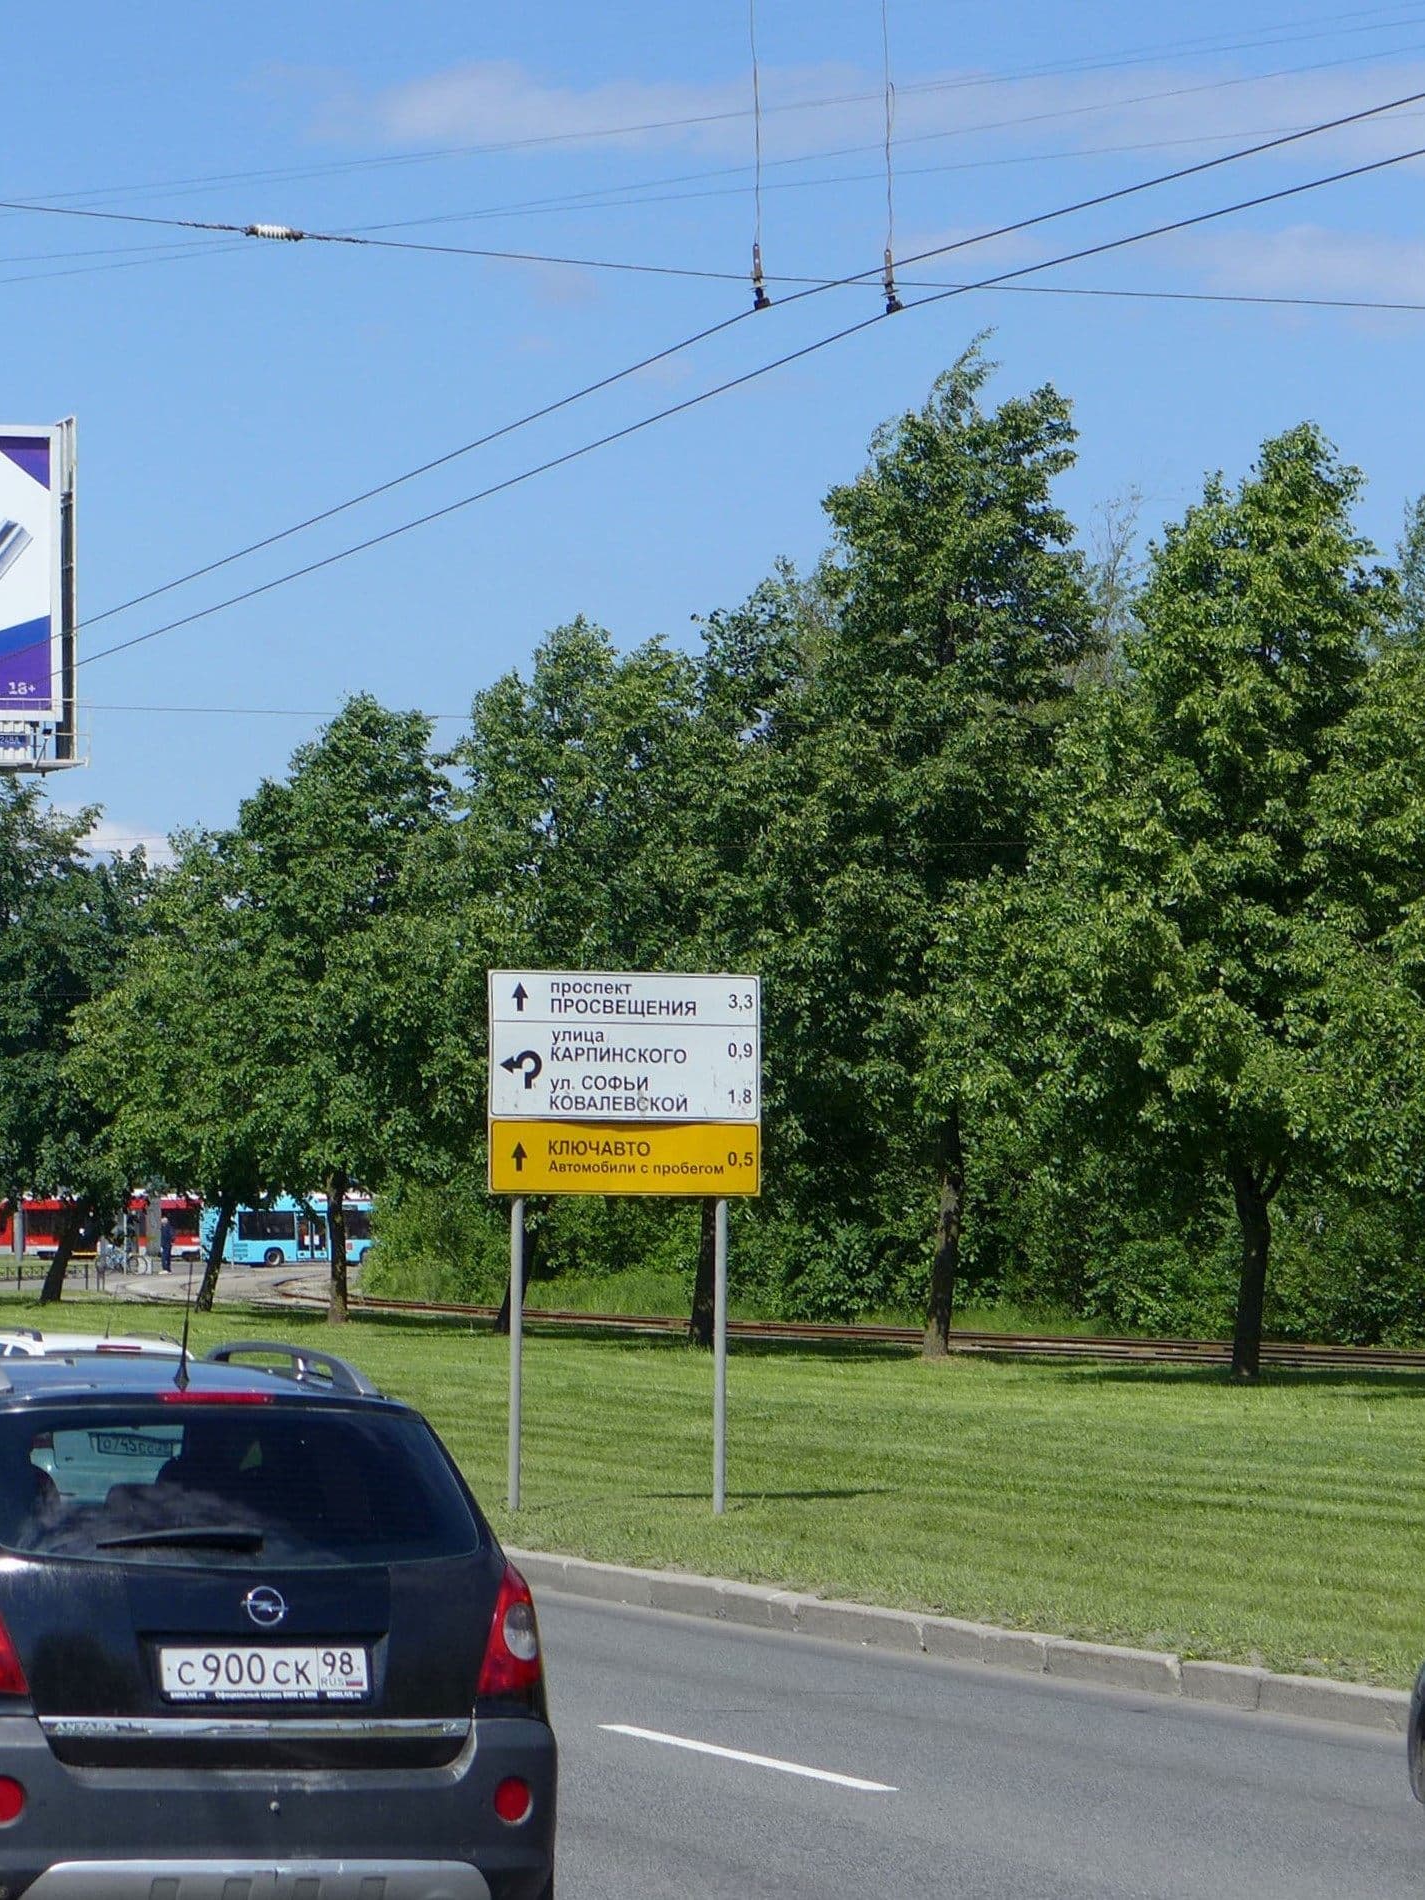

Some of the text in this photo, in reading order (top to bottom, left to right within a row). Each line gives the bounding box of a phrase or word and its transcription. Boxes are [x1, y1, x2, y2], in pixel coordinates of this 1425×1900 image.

[8, 682, 36, 695] 18+
[550, 981, 632, 997] проспект
[550, 994, 753, 1018] ПРОСВЕЩЕНИЯ 3,3
[551, 1029, 604, 1045] улица
[550, 1042, 753, 1064] КАРПИНСКОГО 0,9
[550, 1075, 649, 1094] ул. СОФЬИ
[549, 1088, 752, 1112] КОВАЛЕВСКОЙ 1,8
[548, 1140, 753, 1169] КЛЮЧАВТО 0,5
[548, 1160, 724, 1176] Автомобили с пробегом
[321, 1676, 345, 1687] RUS
